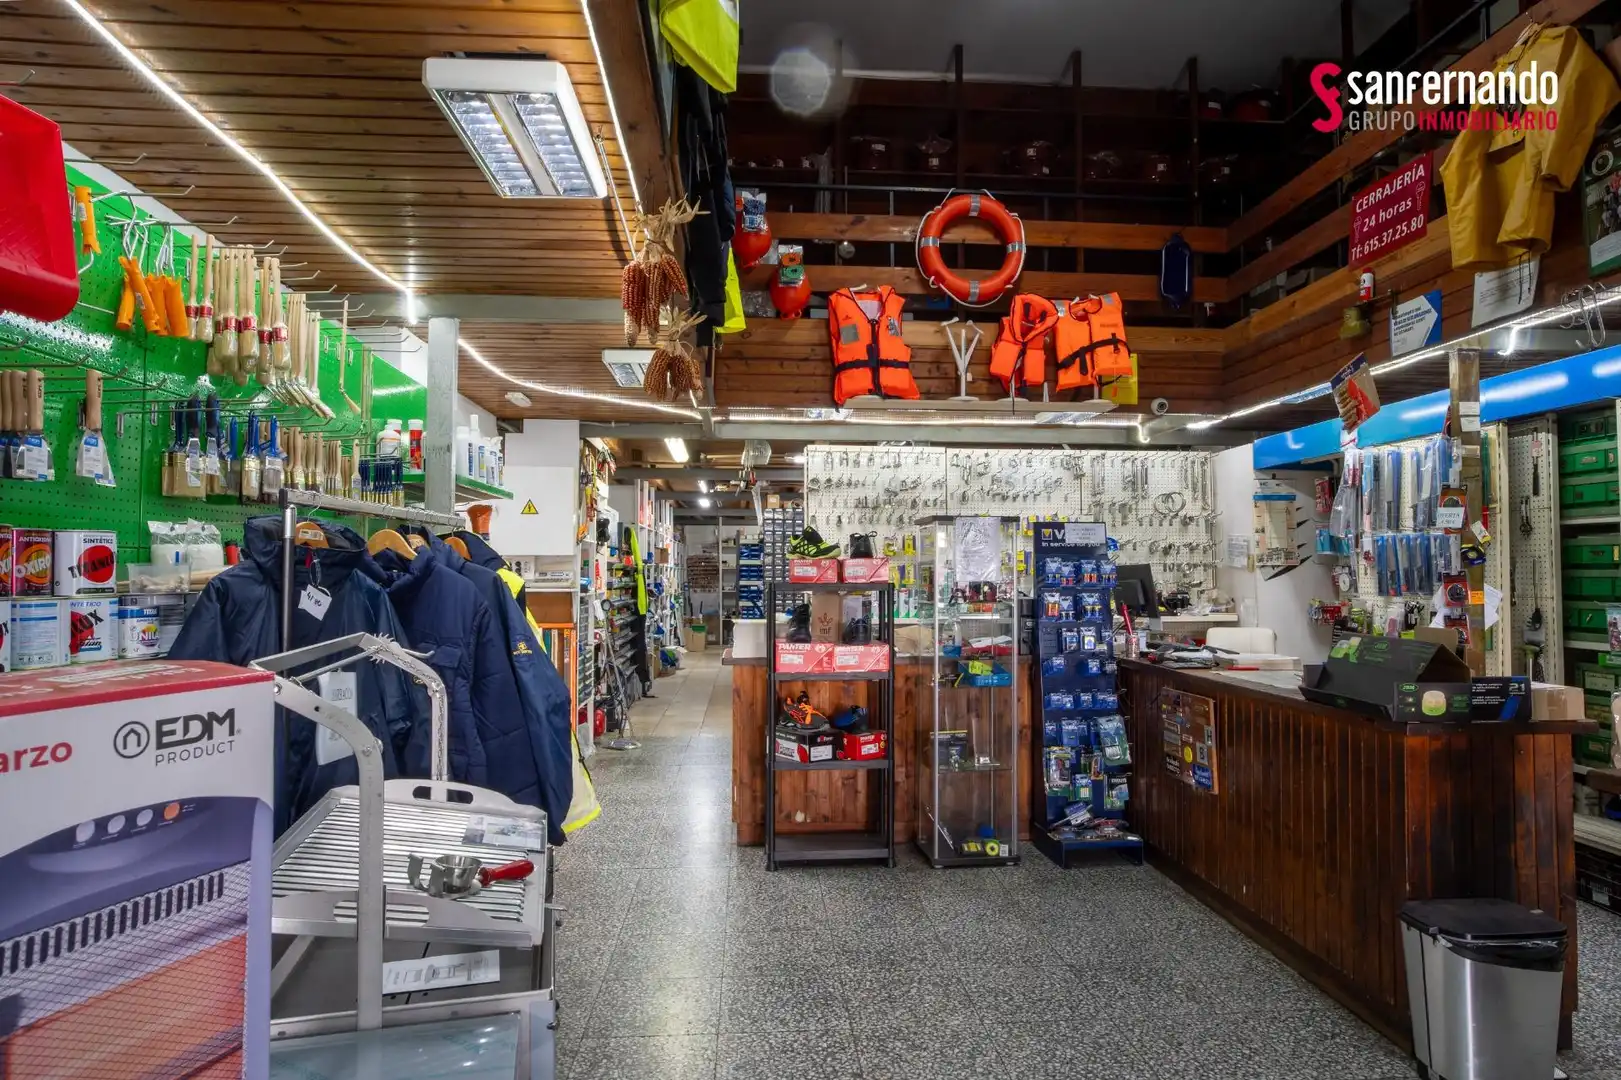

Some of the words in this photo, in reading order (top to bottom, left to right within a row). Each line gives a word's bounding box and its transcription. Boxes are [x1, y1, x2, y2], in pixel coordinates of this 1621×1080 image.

[1355, 163, 1425, 213] CERRAJERÍA
[1363, 214, 1376, 232] 24
[1379, 197, 1412, 223] horas
[778, 643, 811, 651] PANTER
[1509, 682, 1525, 692] 21
[156, 708, 235, 750] EDM
[155, 740, 235, 766] PRODUCT
